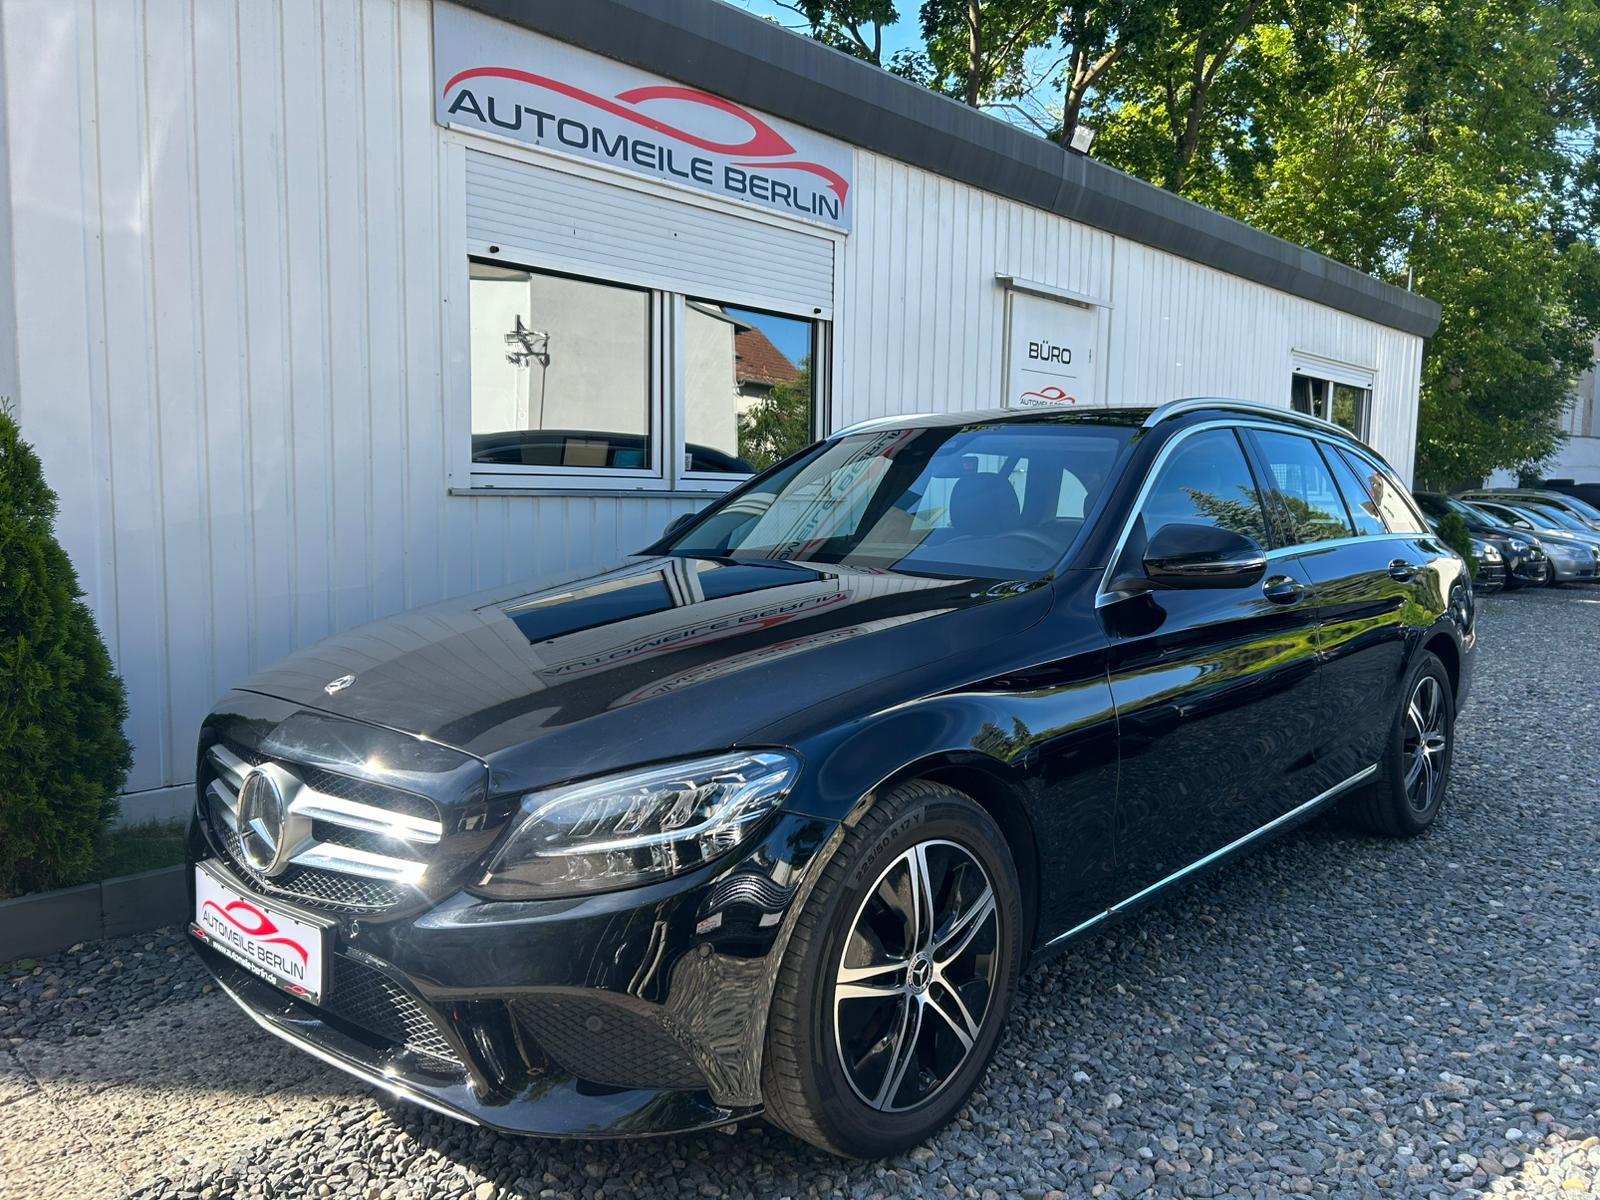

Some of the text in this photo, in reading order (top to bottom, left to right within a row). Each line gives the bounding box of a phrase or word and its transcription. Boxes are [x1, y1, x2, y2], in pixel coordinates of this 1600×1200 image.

[447, 88, 839, 221] AUTOMEILE BERLIN
[1028, 340, 1072, 365] BÜRO
[202, 910, 305, 981] AUTOMEILE BERLIN
